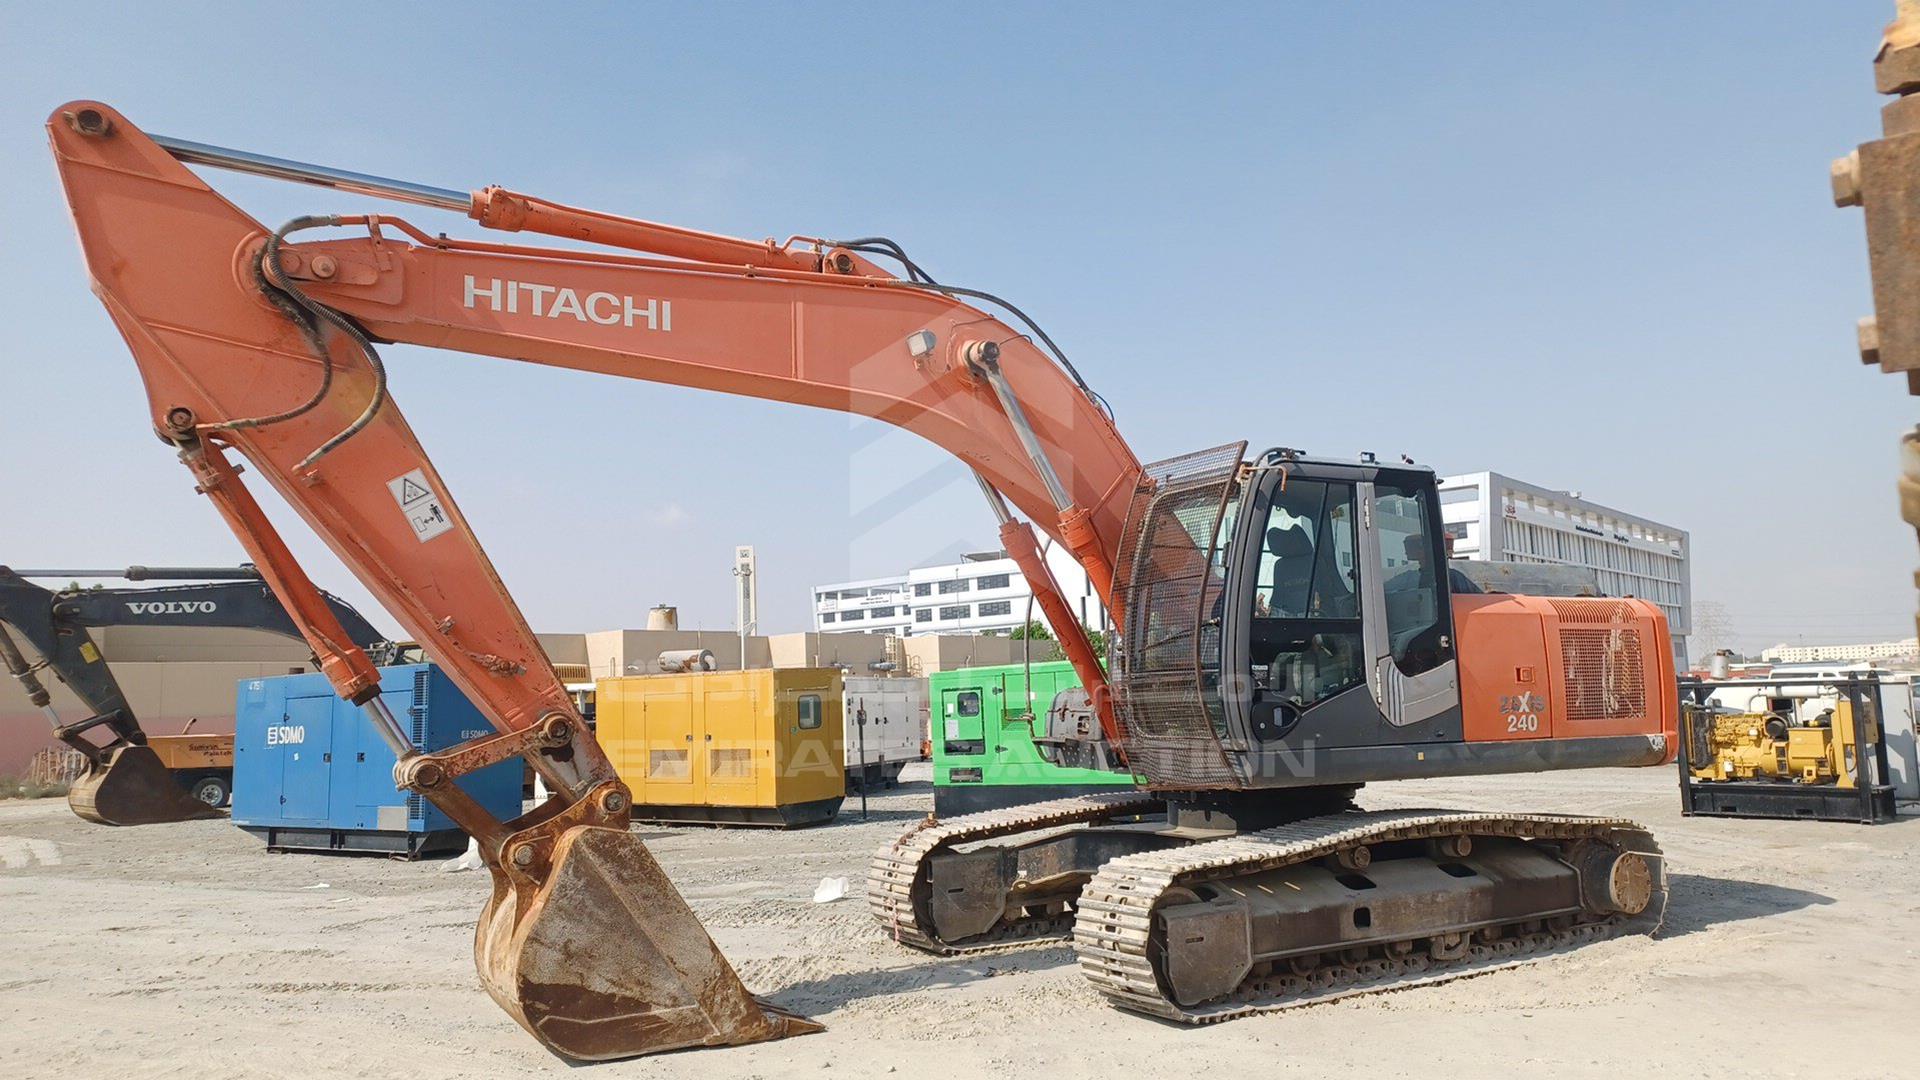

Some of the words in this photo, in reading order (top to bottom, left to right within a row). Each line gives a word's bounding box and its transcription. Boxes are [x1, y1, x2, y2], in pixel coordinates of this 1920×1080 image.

[464, 274, 671, 331] HITACHI
[125, 601, 217, 614] VOLVO
[1507, 714, 1538, 732] 240
[279, 725, 305, 744] SDMO
